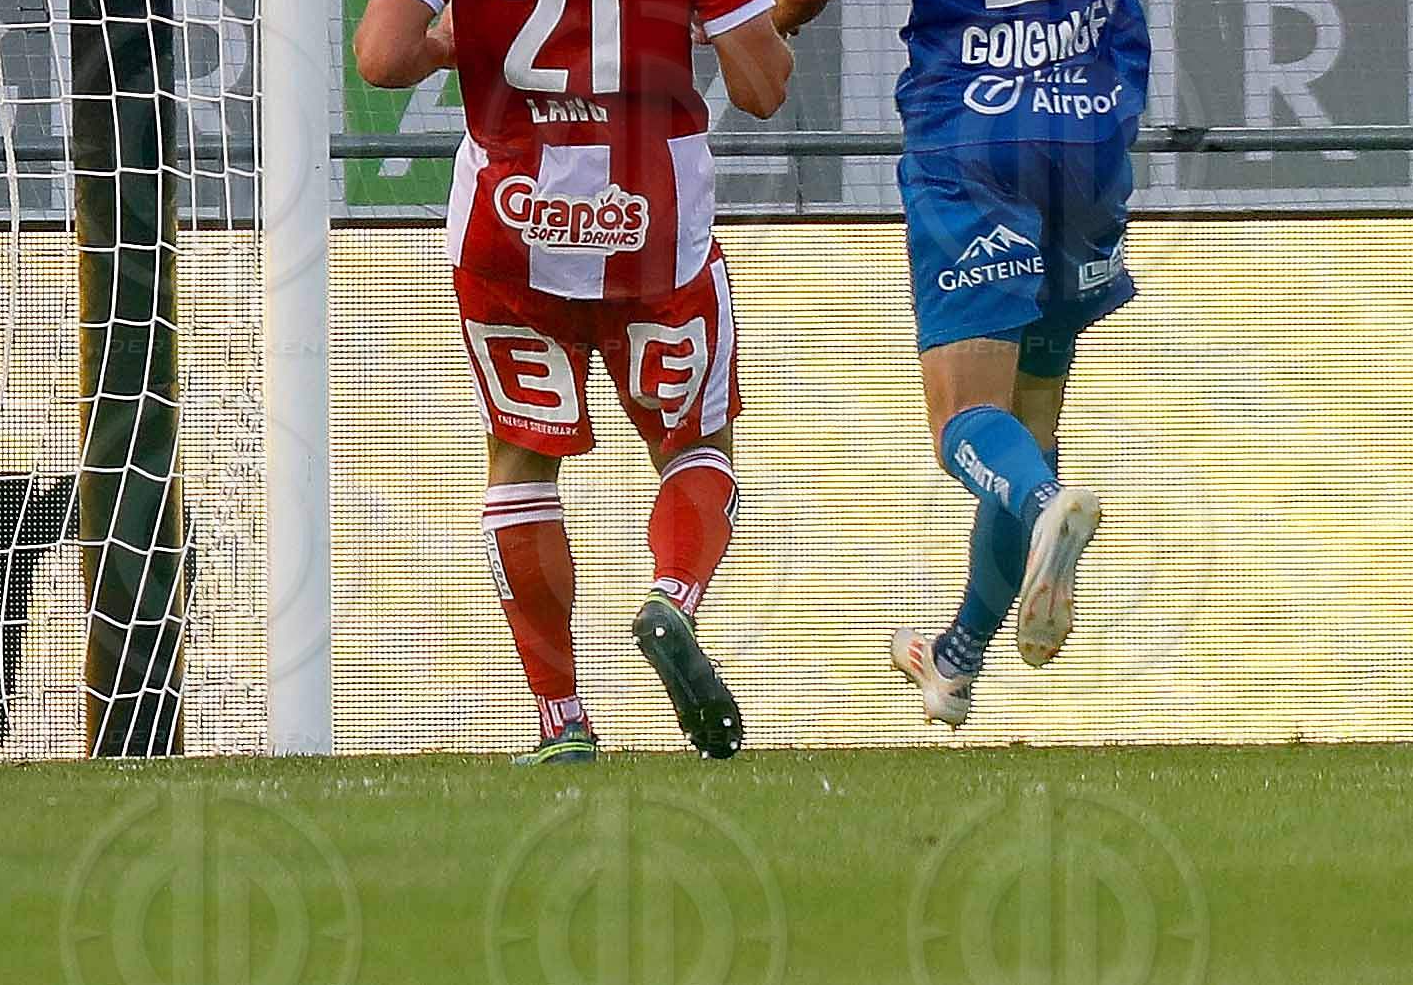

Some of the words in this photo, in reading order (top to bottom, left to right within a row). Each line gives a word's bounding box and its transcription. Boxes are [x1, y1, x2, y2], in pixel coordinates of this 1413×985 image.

[525, 97, 609, 125] LANG
[1032, 85, 1123, 120] Airpor
[526, 226, 568, 242] SOFT
[581, 228, 640, 247] DRINKS
[938, 255, 1045, 292] GASTEINE
